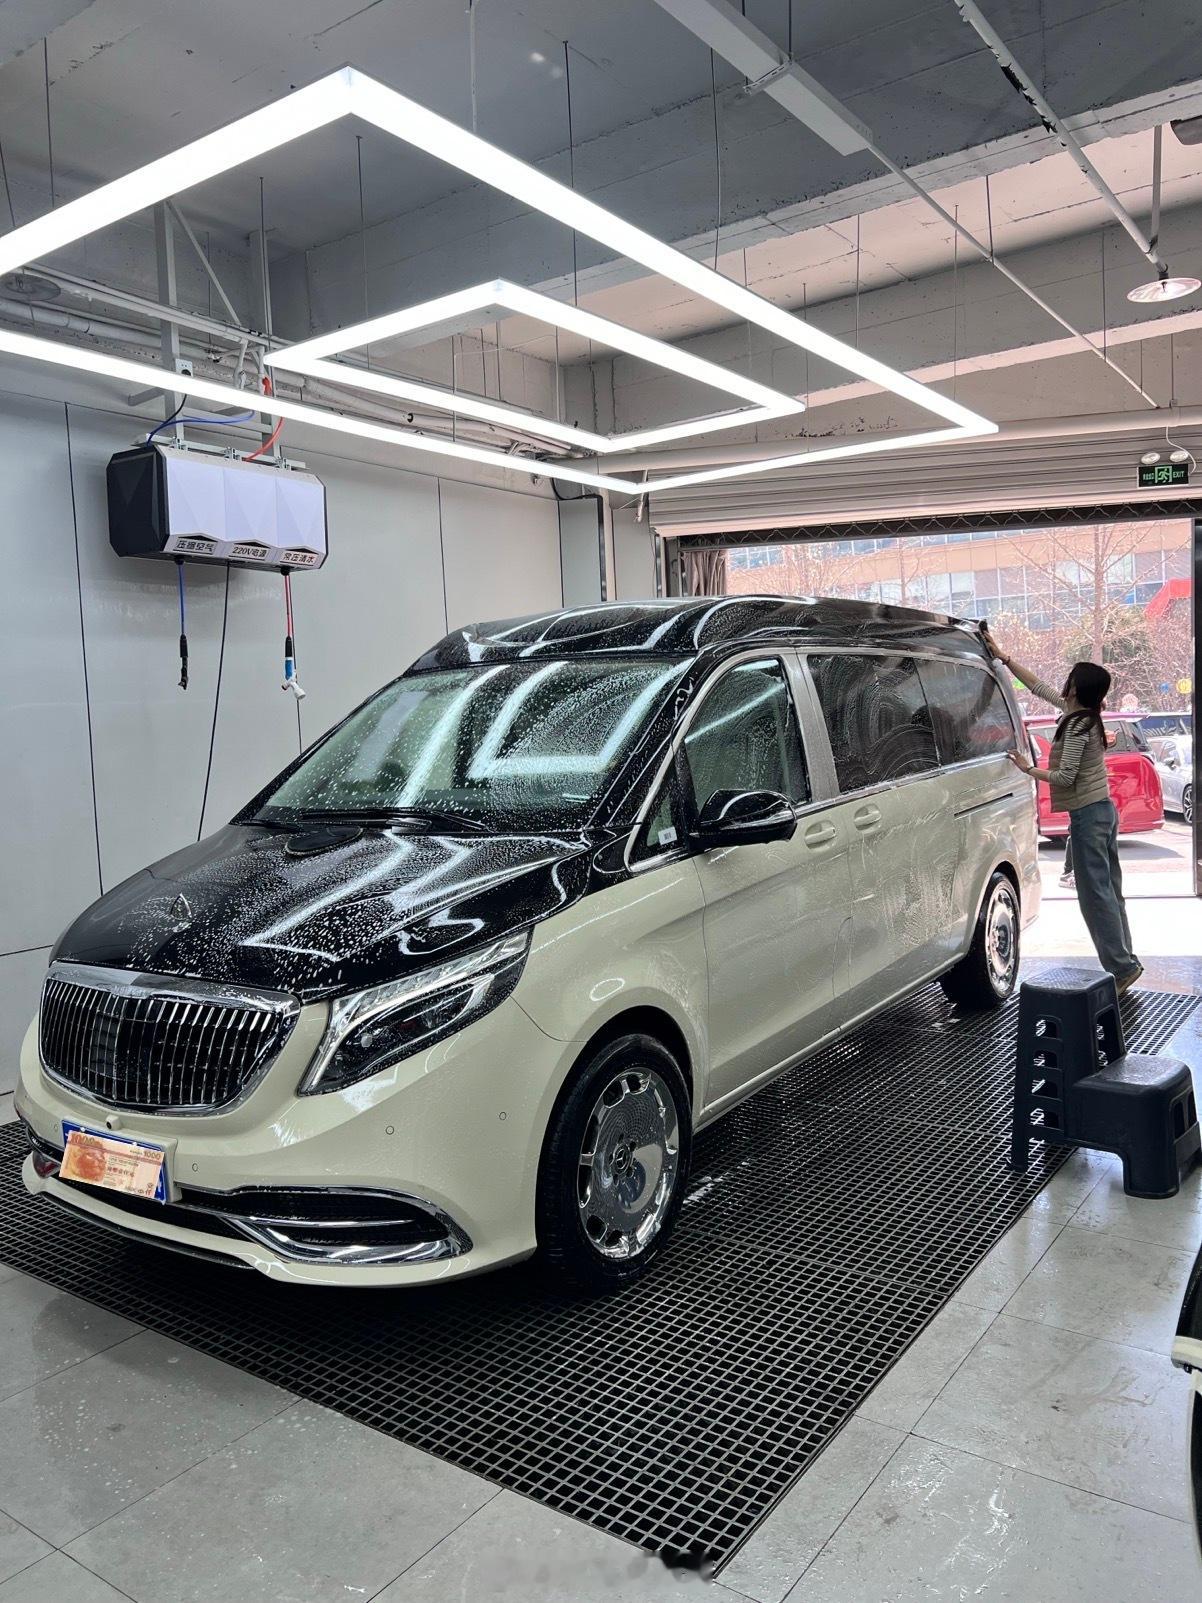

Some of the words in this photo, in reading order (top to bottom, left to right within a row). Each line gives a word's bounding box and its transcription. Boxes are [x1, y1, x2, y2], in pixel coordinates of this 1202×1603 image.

[1172, 471, 1185, 479] EXIT
[176, 540, 214, 552] 压缩空气
[232, 546, 267, 557] 220V电源
[283, 552, 315, 563] 常压清水
